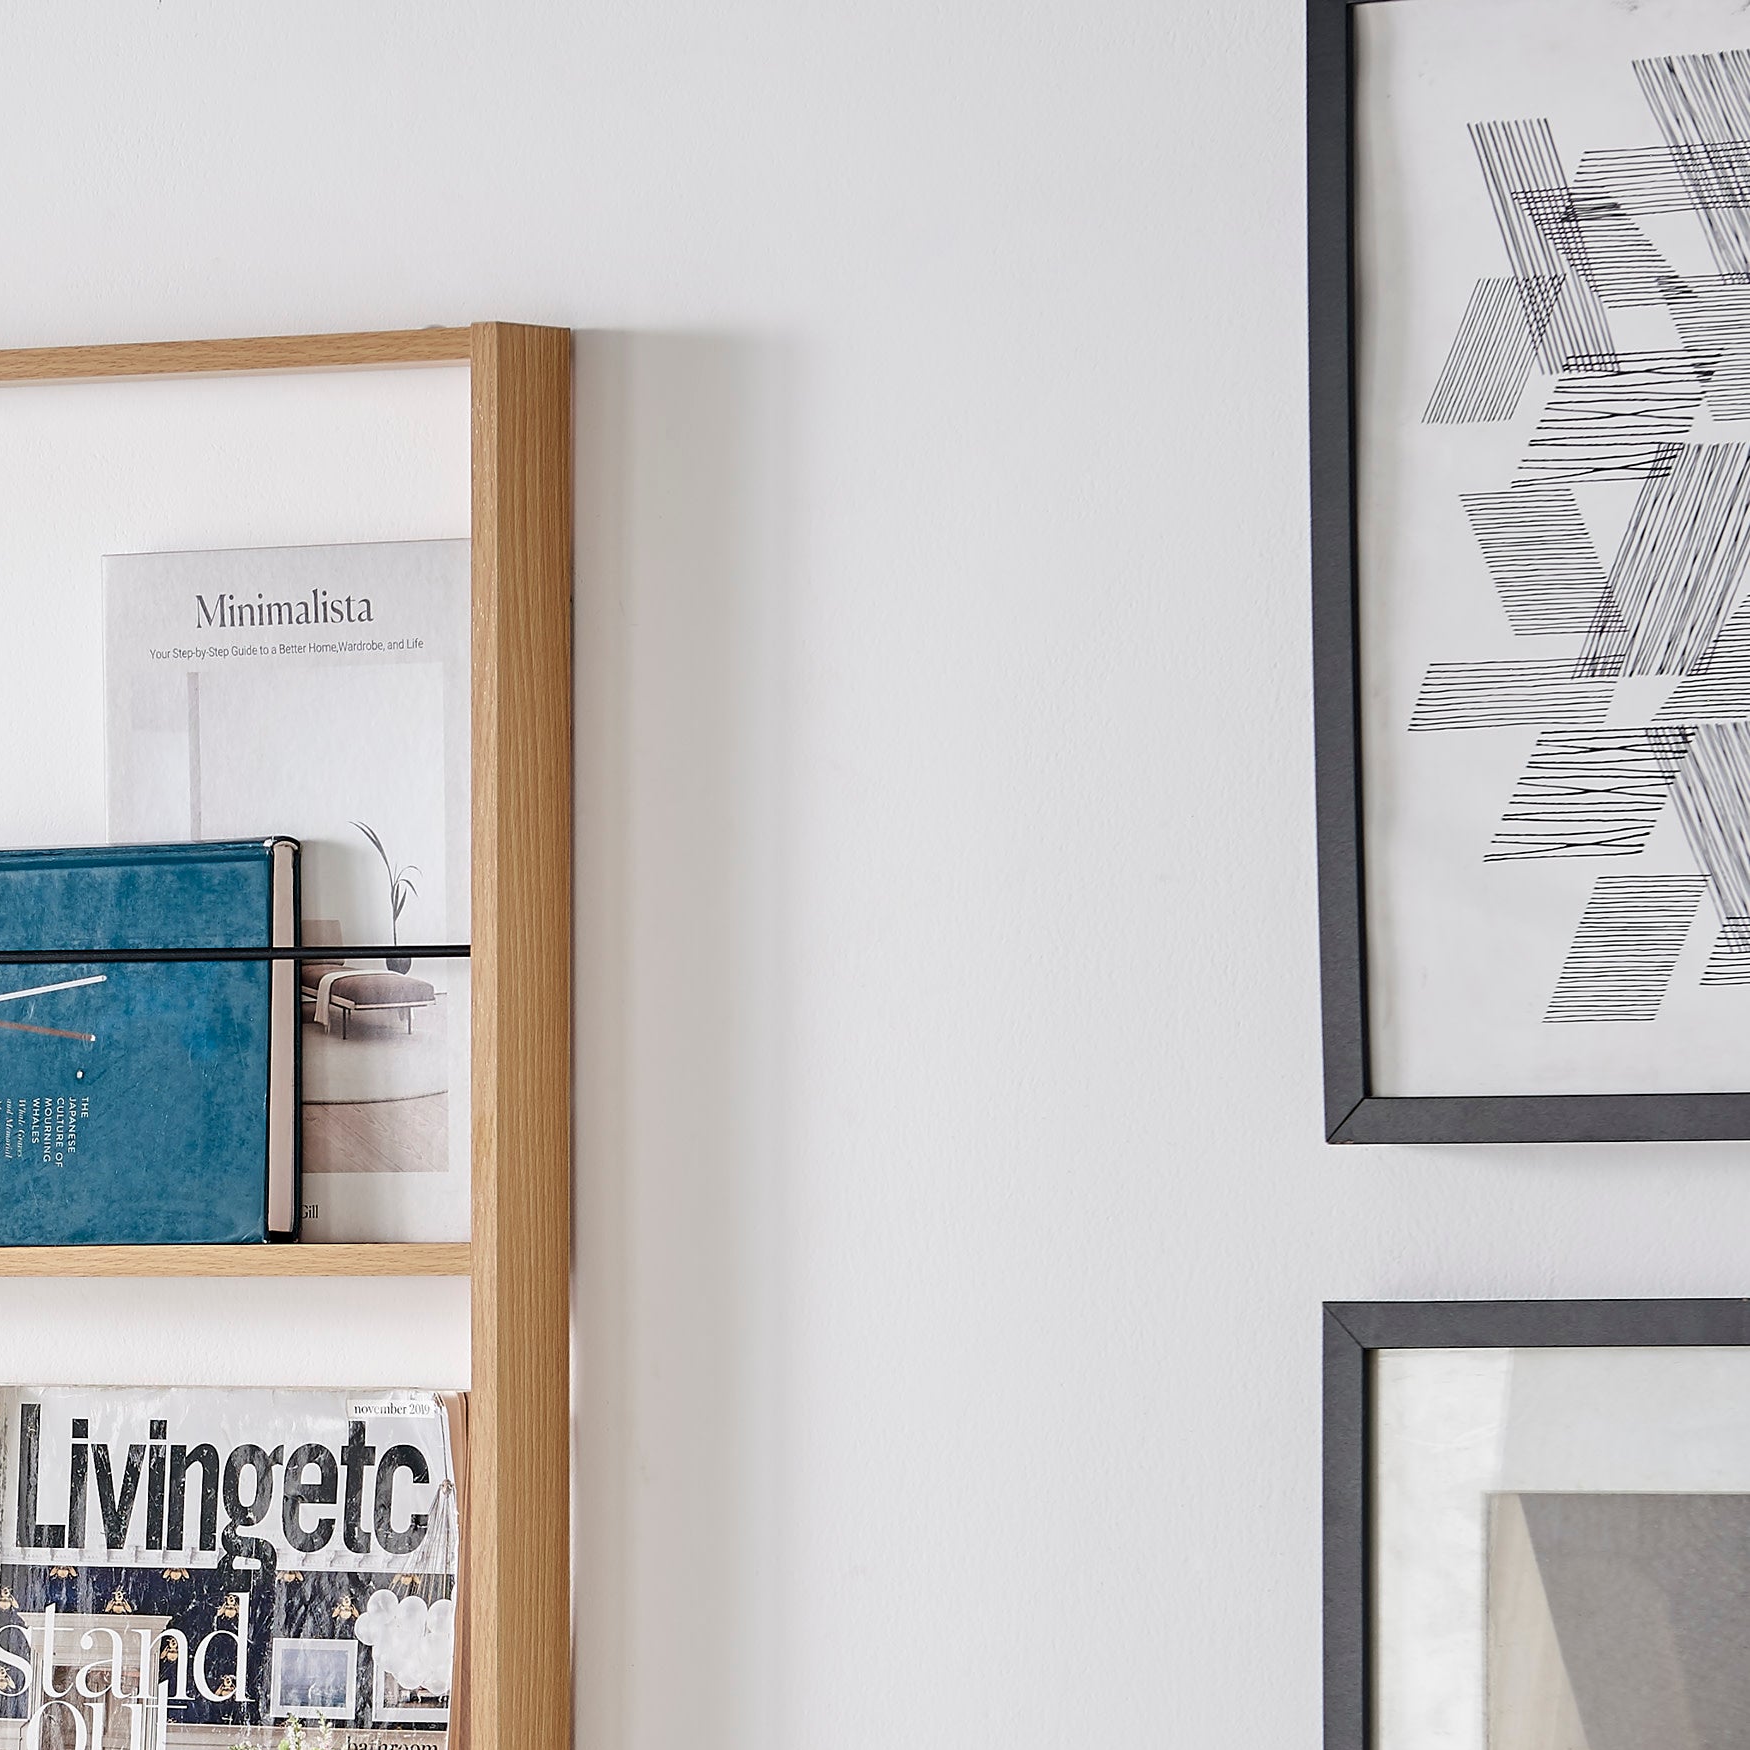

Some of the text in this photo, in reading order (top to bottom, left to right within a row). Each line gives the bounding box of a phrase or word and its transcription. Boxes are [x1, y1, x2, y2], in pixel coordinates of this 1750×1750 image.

[196, 588, 374, 629] Minimalista
[150, 649, 170, 660] Your
[172, 646, 229, 660] Step-by-Step
[231, 645, 257, 657] Guide
[259, 645, 269, 655] to
[271, 646, 277, 655] a
[279, 643, 306, 654] Better
[387, 639, 404, 650] and
[406, 638, 424, 649] Life
[5, 1098, 14, 1159] and Memorial
[18, 1099, 26, 1127] Whale
[31, 1097, 41, 1144] WHALES
[43, 1097, 53, 1163] MOURNING
[67, 1096, 77, 1153] JAPANESE
[81, 1096, 89, 1118] THE
[55, 1097, 65, 1168] CULTURE OF
[354, 1402, 430, 1415] november 2019
[15, 1403, 431, 1588] Livingetc
